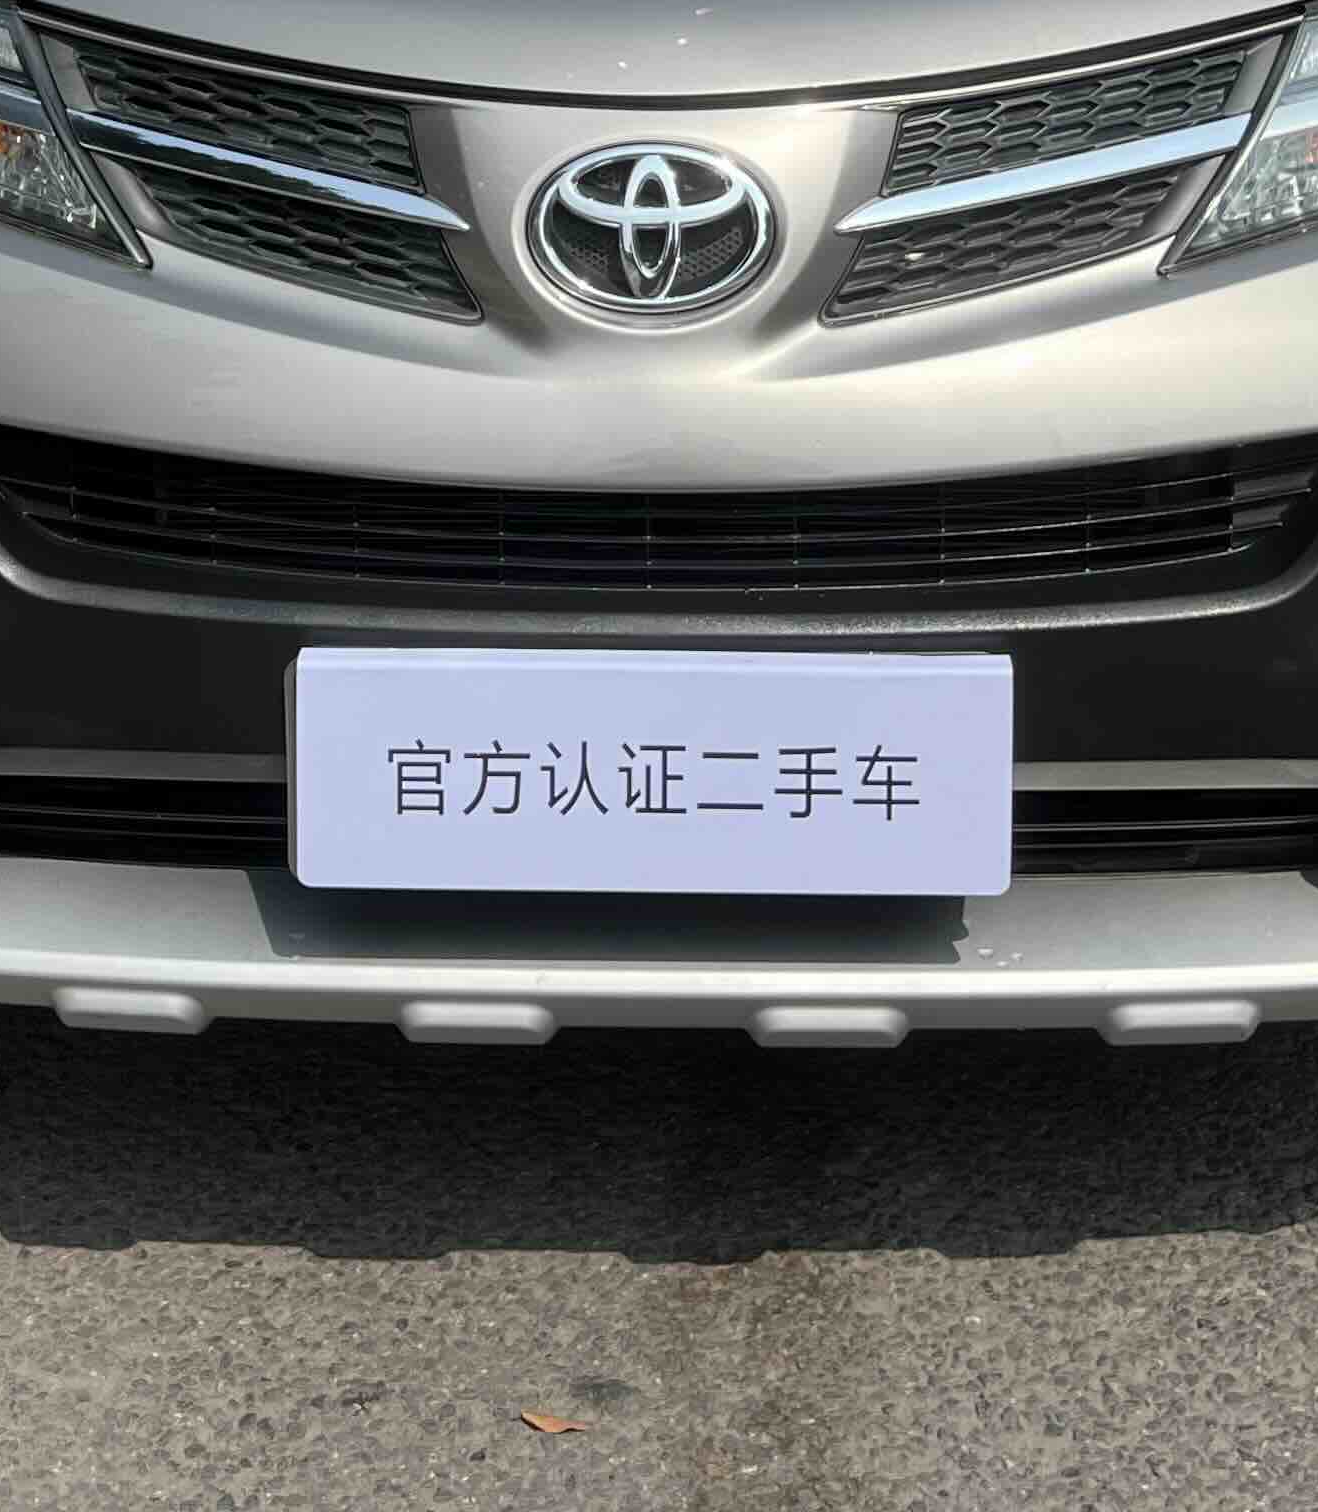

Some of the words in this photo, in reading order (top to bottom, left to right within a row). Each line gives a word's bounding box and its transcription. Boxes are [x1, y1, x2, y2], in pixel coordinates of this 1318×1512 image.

[387, 739, 920, 821] 官方认证二手车
